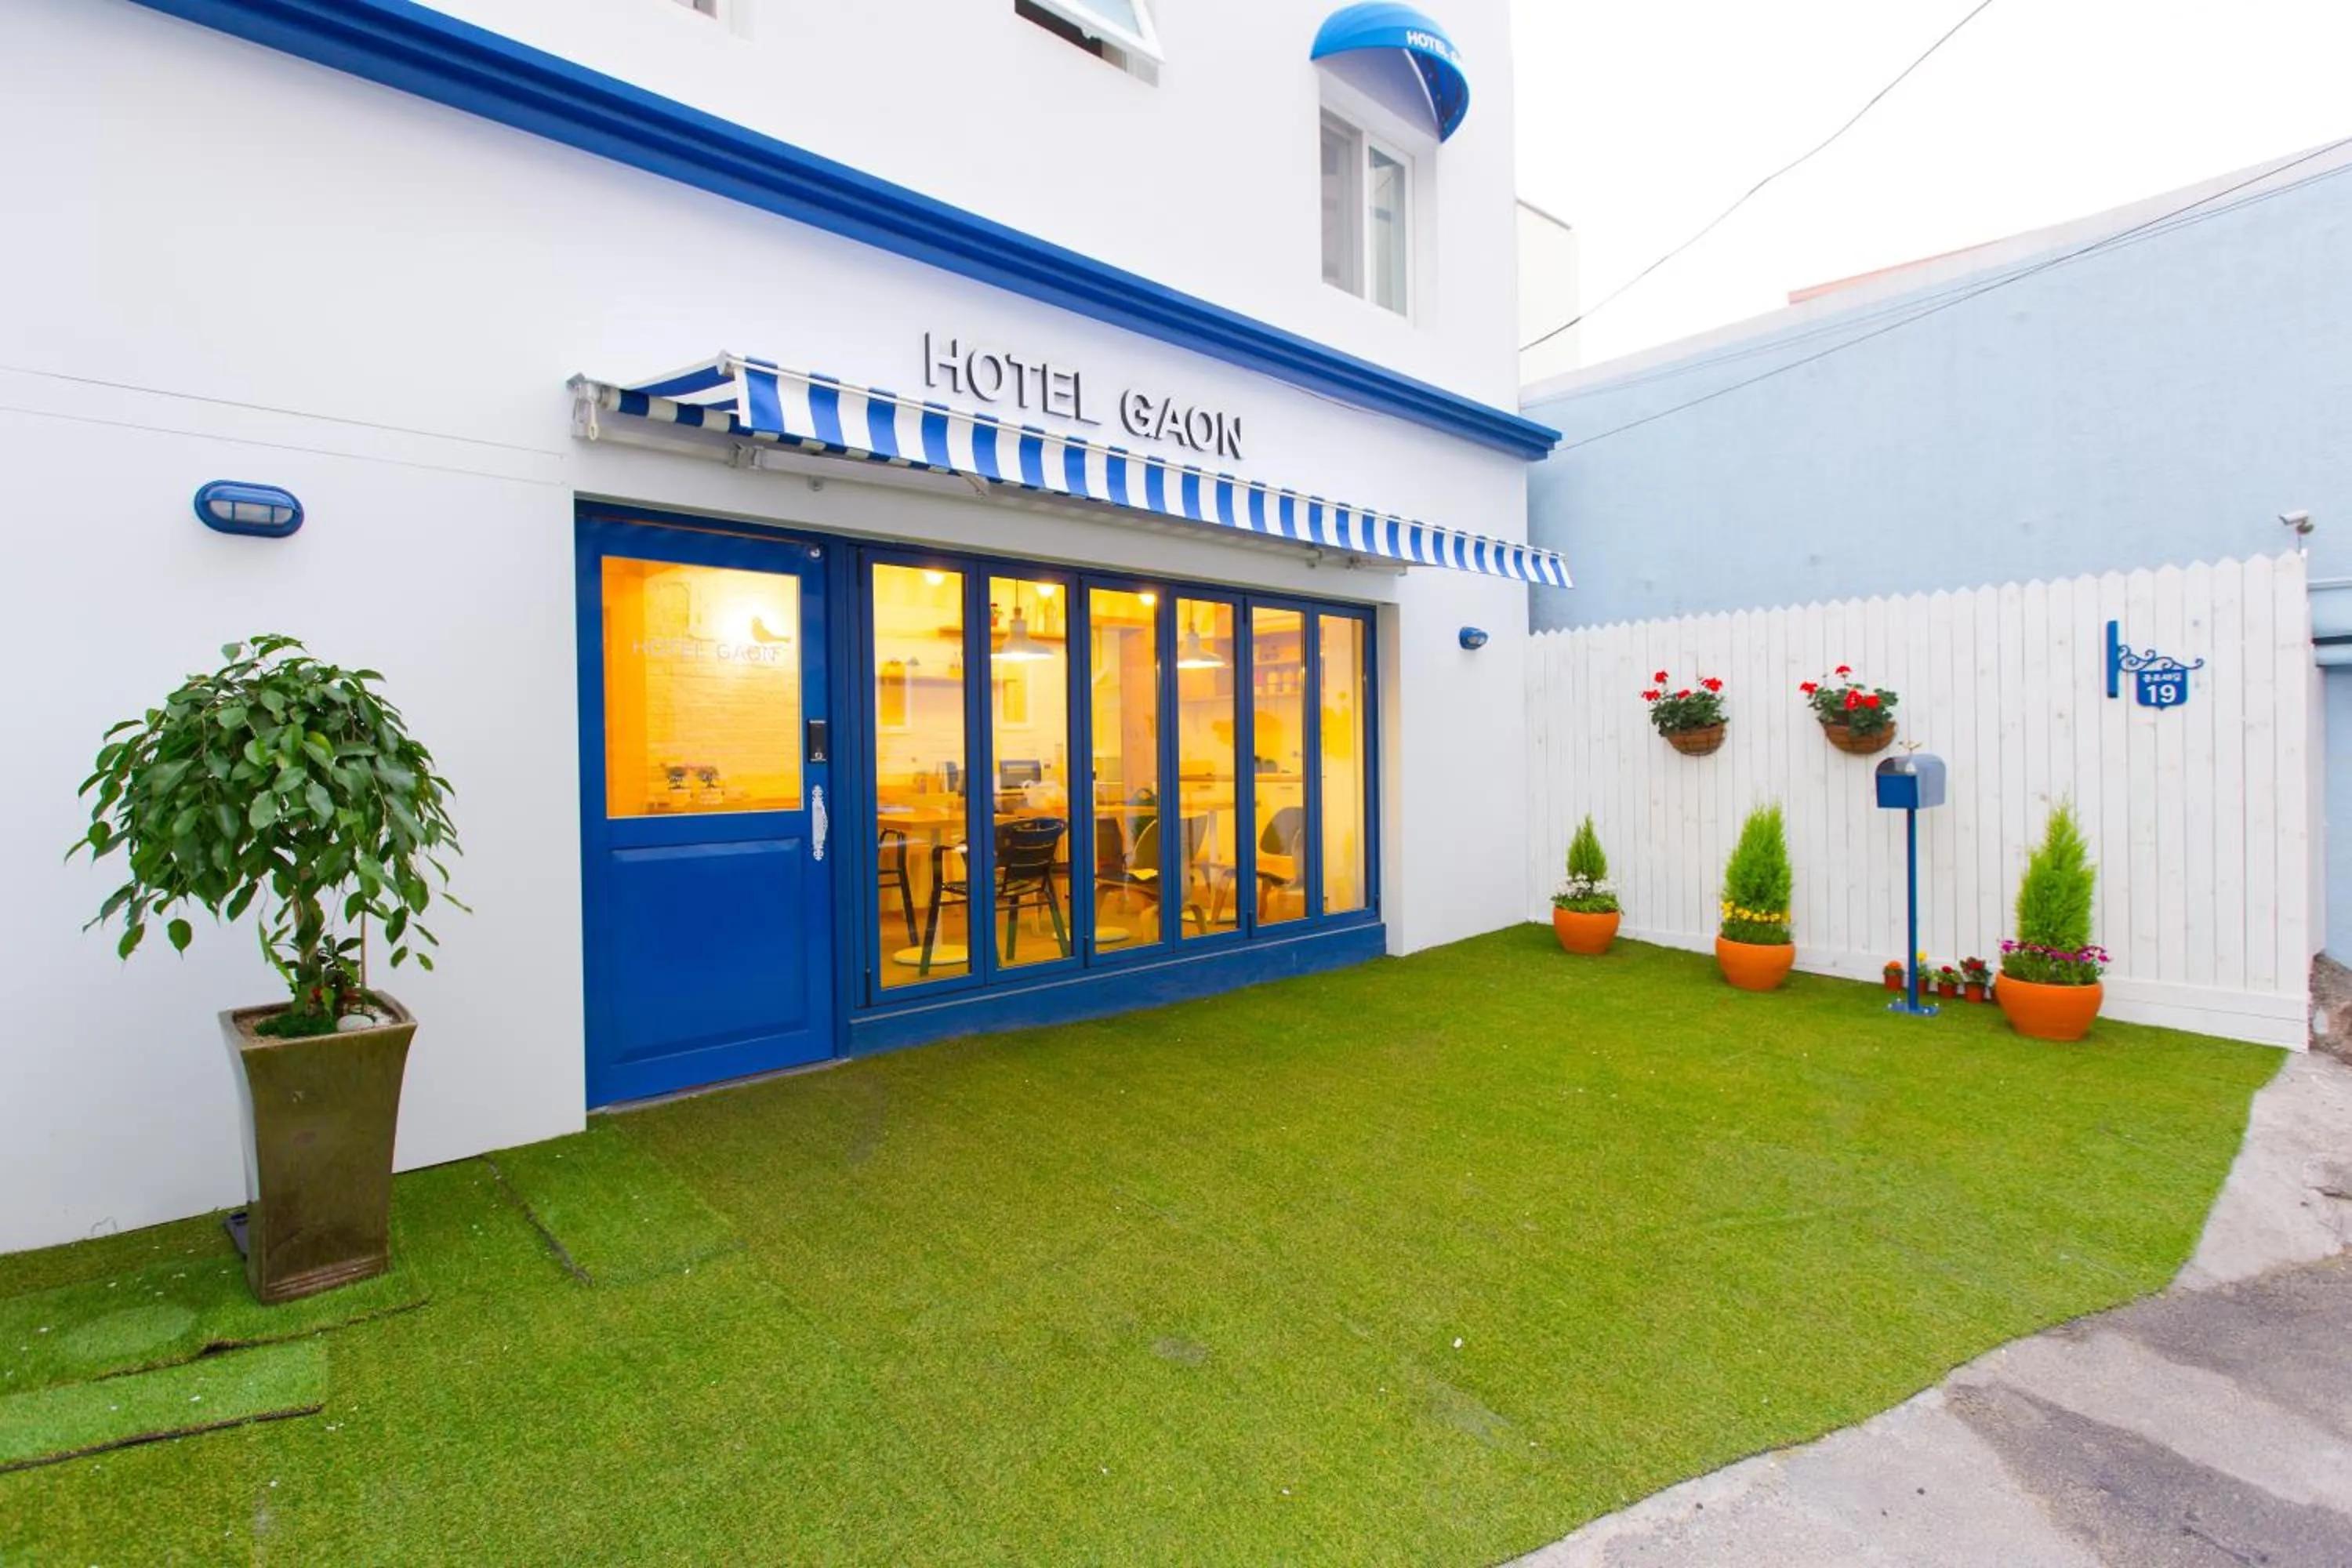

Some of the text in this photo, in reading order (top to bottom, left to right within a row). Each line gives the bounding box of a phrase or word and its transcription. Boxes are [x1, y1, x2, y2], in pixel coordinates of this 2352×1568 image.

[1406, 30, 1448, 58] HOTEL
[924, 331, 1244, 460] HOTEL GAON
[2147, 684, 2177, 703] 19
